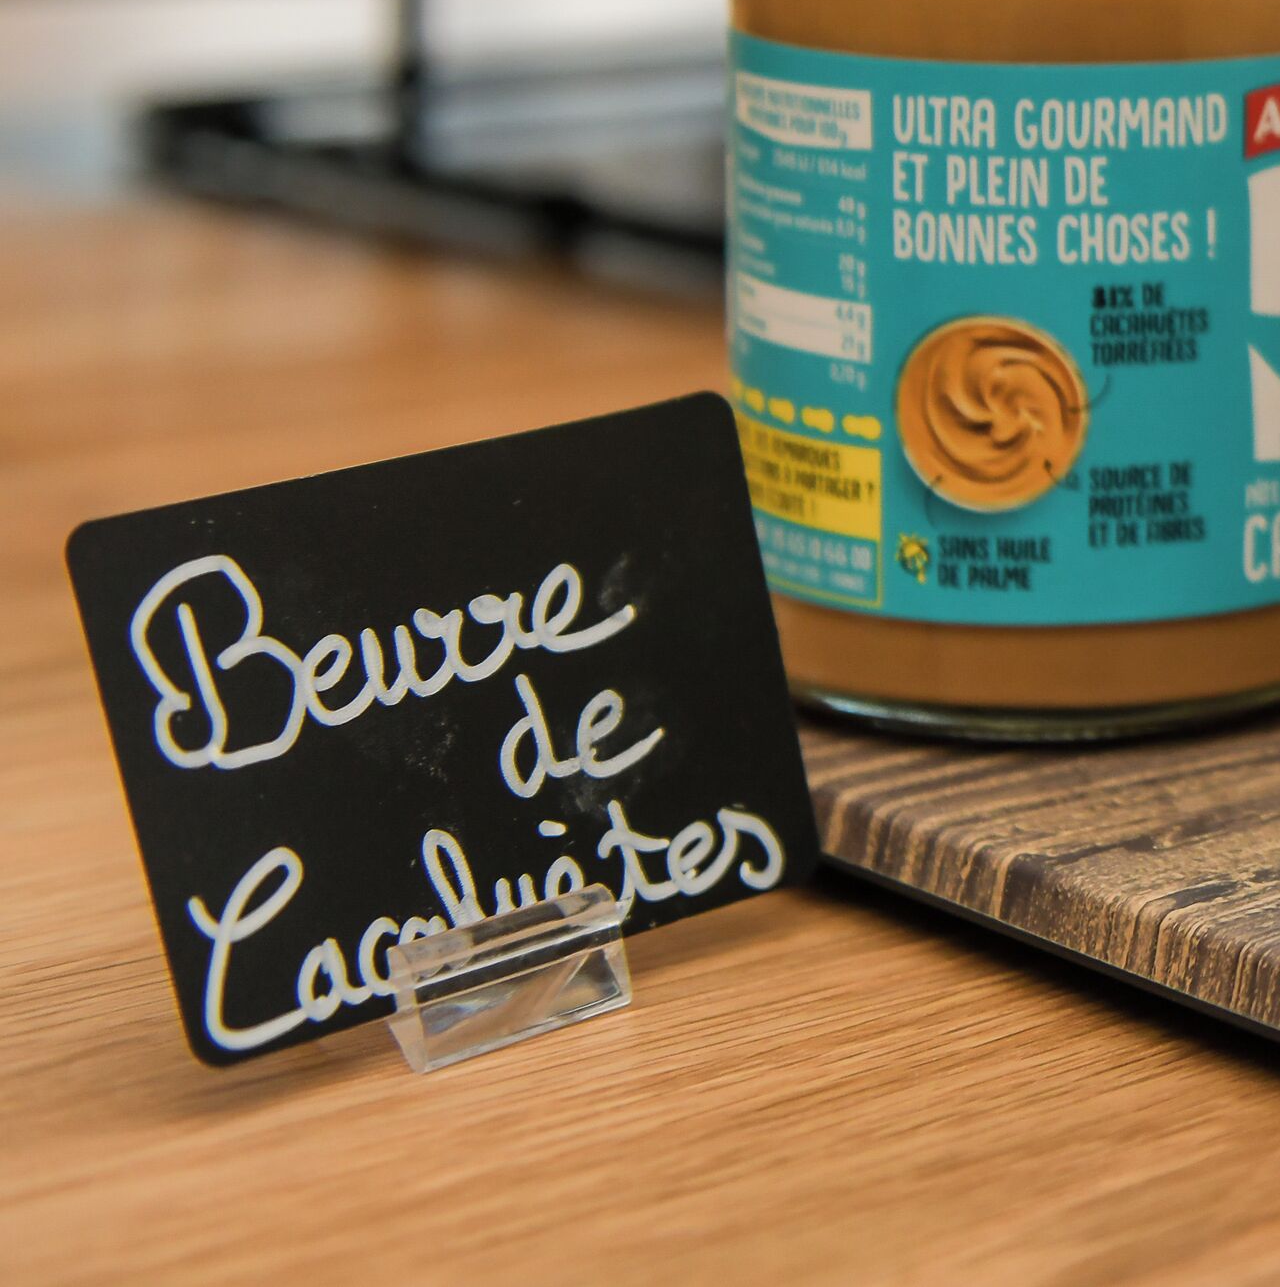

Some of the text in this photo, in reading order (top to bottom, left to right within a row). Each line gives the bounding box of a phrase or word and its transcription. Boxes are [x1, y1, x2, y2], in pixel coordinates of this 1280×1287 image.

[893, 93, 1228, 150] ULTRA GOURMAND
[893, 150, 1109, 208] ET PLEIN DE
[893, 209, 1038, 264] BONNES
[1056, 211, 1191, 265] CHOSES
[1142, 281, 1164, 307] DE
[1089, 460, 1193, 492] SOURCE DE
[938, 535, 1052, 563] SANS HUILE
[1089, 521, 1109, 548] ET
[1116, 521, 1140, 547] DE
[937, 564, 1031, 592] DE PALME
[130, 553, 637, 771] Beurre
[499, 672, 666, 799] de
